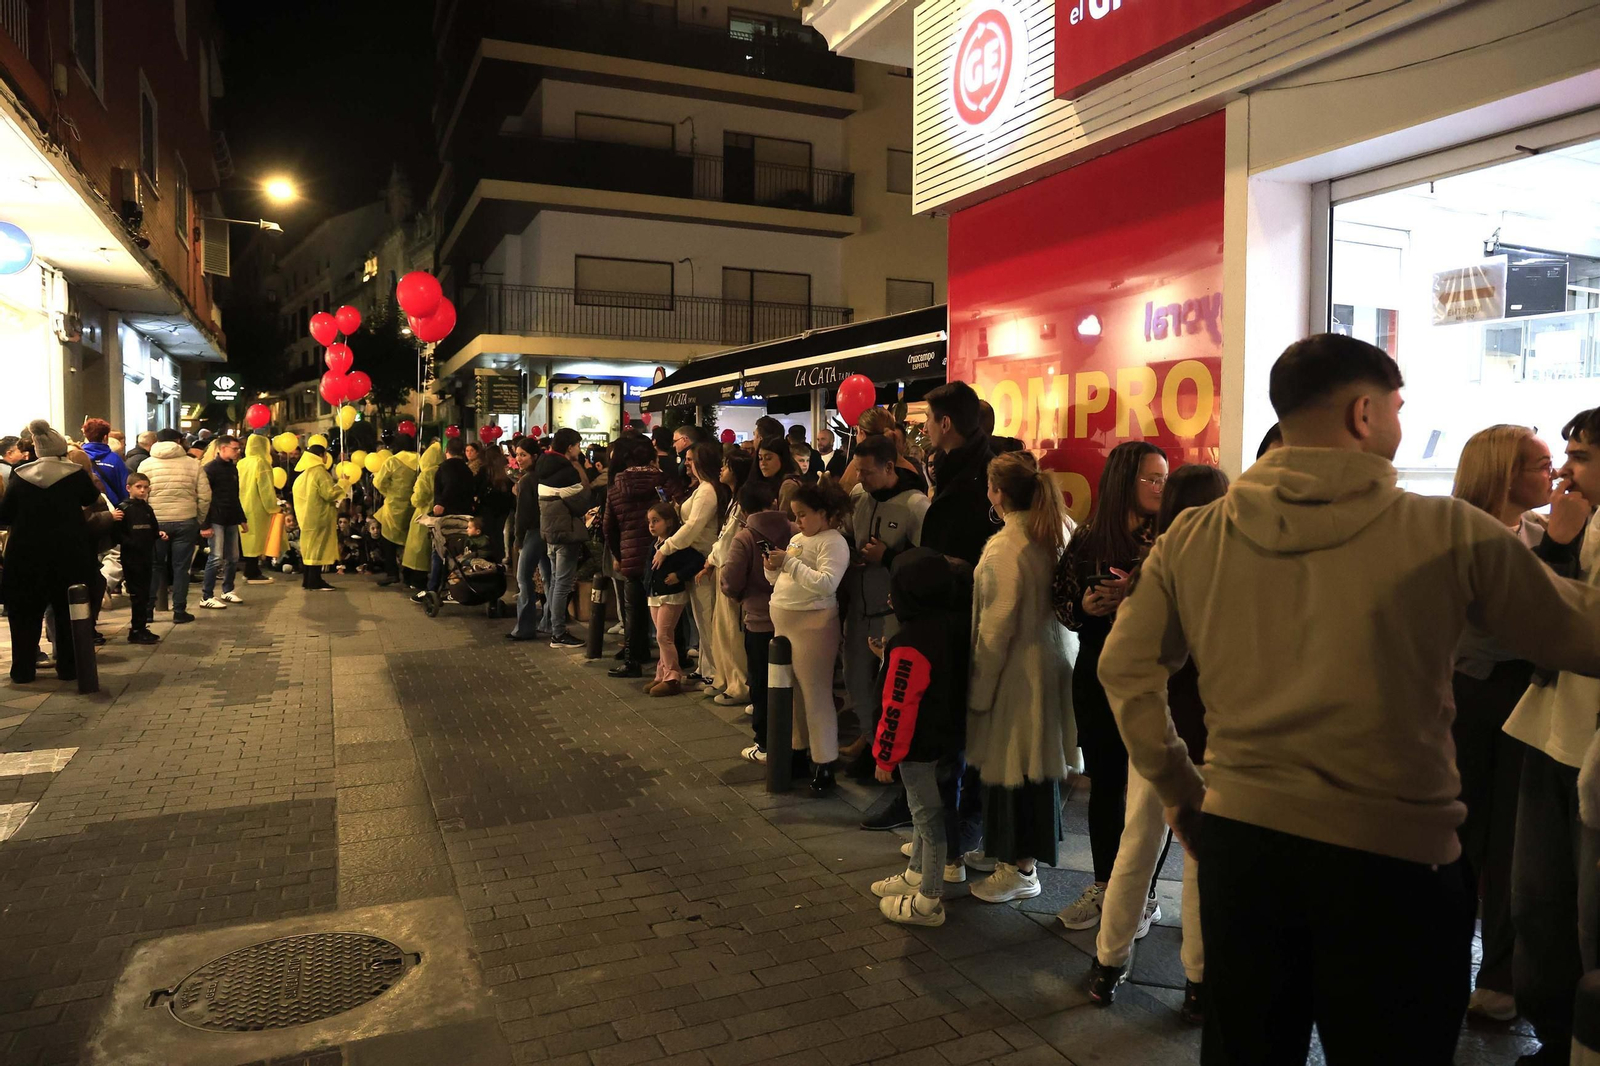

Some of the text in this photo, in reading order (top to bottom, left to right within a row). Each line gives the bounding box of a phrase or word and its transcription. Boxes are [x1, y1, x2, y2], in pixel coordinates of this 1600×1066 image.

[964, 37, 1000, 93] GE
[907, 351, 935, 364] Cruzcampo
[912, 361, 930, 370] ESPECIAL
[795, 370, 807, 387] LA
[808, 366, 837, 386] CATA
[672, 392, 688, 407] CATA
[969, 360, 1213, 440] OMPRO
[892, 658, 913, 704] HIGH
